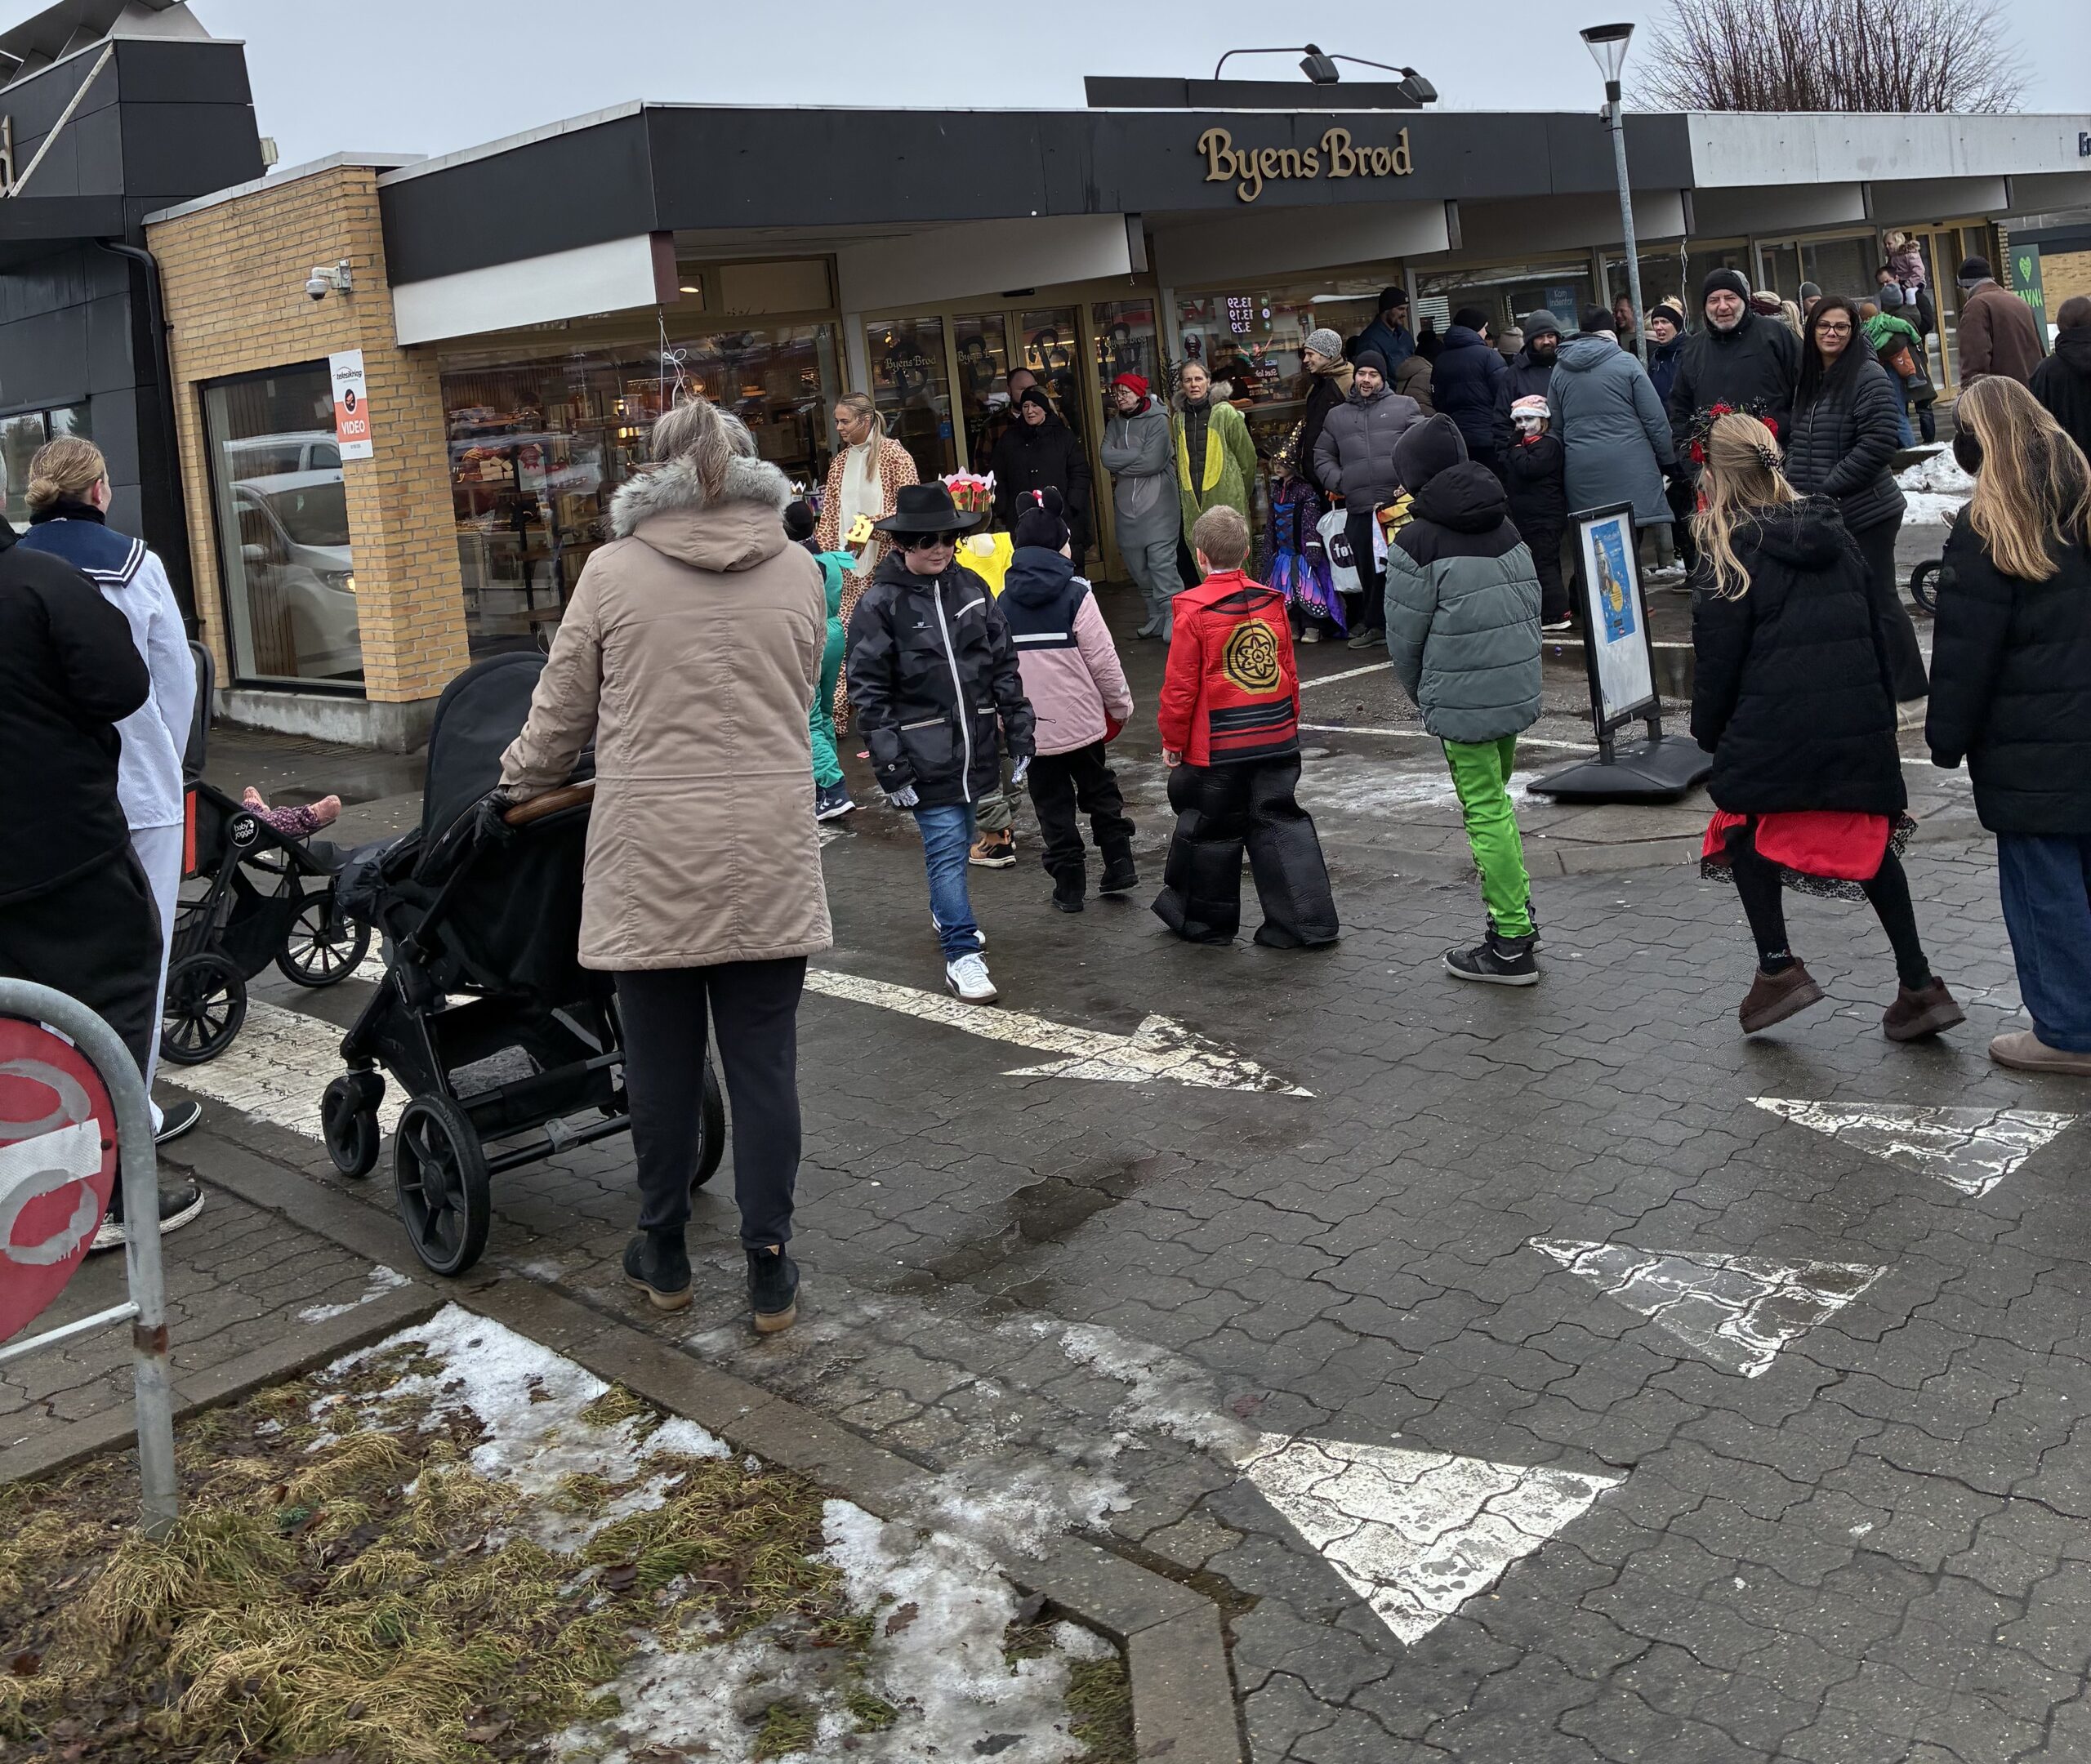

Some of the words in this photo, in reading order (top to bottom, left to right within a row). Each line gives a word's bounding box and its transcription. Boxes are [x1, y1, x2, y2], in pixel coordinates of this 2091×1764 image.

[1197, 127, 1320, 203] Byens
[1320, 127, 1415, 179] Brød
[885, 358, 912, 372] Byens
[337, 370, 362, 381] telesikring
[341, 420, 366, 434] VIDEO
[234, 822, 249, 831] baby
[234, 828, 254, 840] jogger
